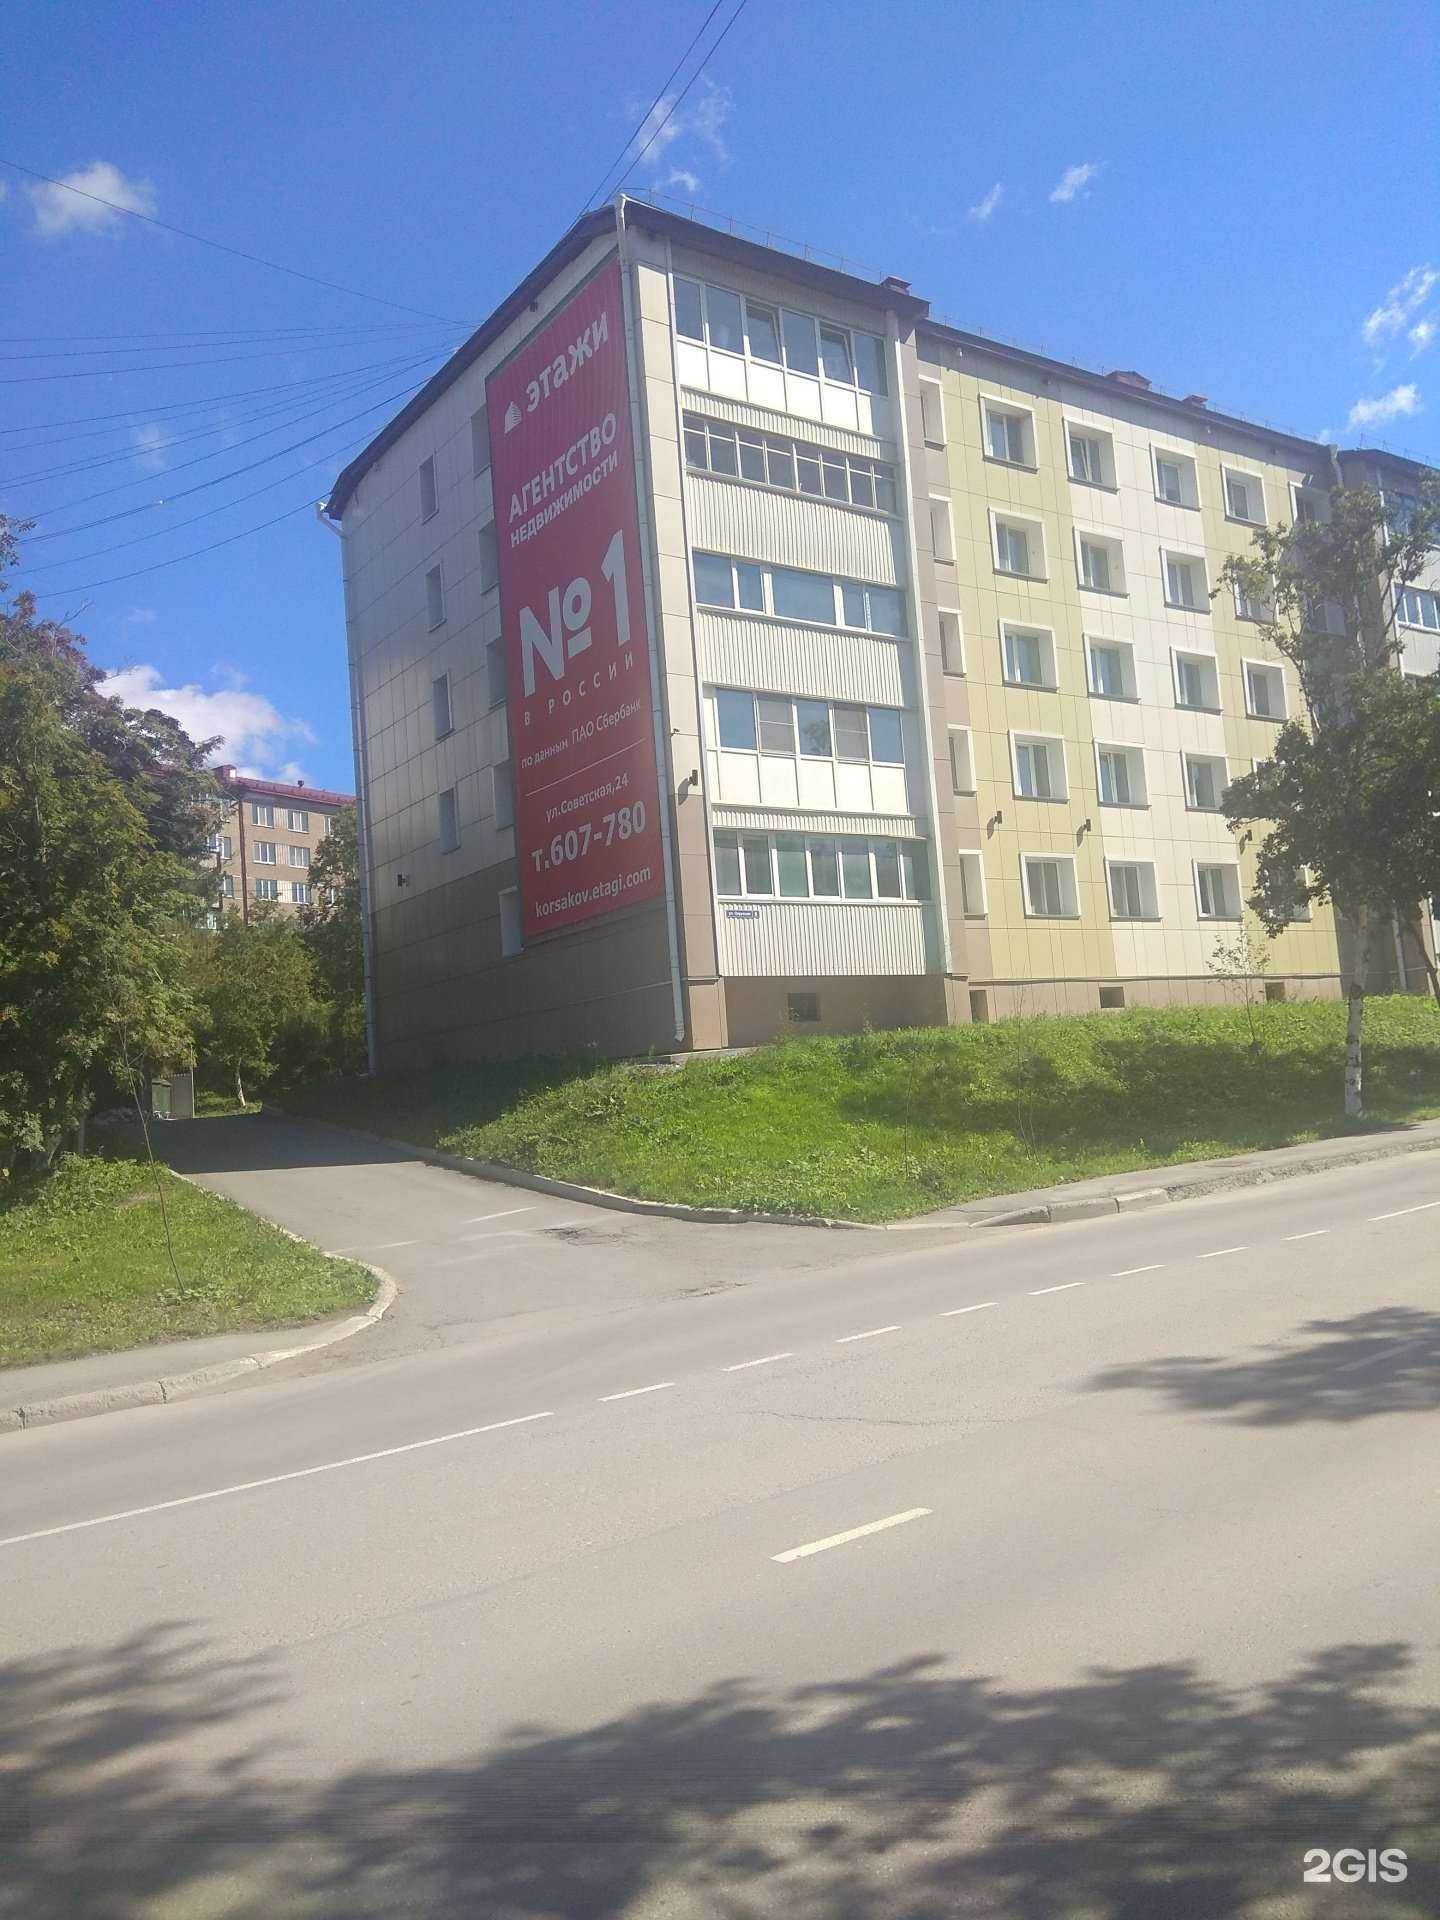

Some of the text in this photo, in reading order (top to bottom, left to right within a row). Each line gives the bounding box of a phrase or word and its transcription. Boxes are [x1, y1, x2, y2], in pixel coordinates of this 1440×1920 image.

[509, 411, 618, 523] АГЕНТСТВО
[510, 450, 619, 548] НЕДВИЖИМОСТИ
[548, 651, 634, 714] РОССИИ
[521, 756, 533, 769] по
[571, 720, 595, 745] ПАО
[596, 698, 642, 732] Сбербанк
[534, 865, 651, 918] korsakov.etagi.com
